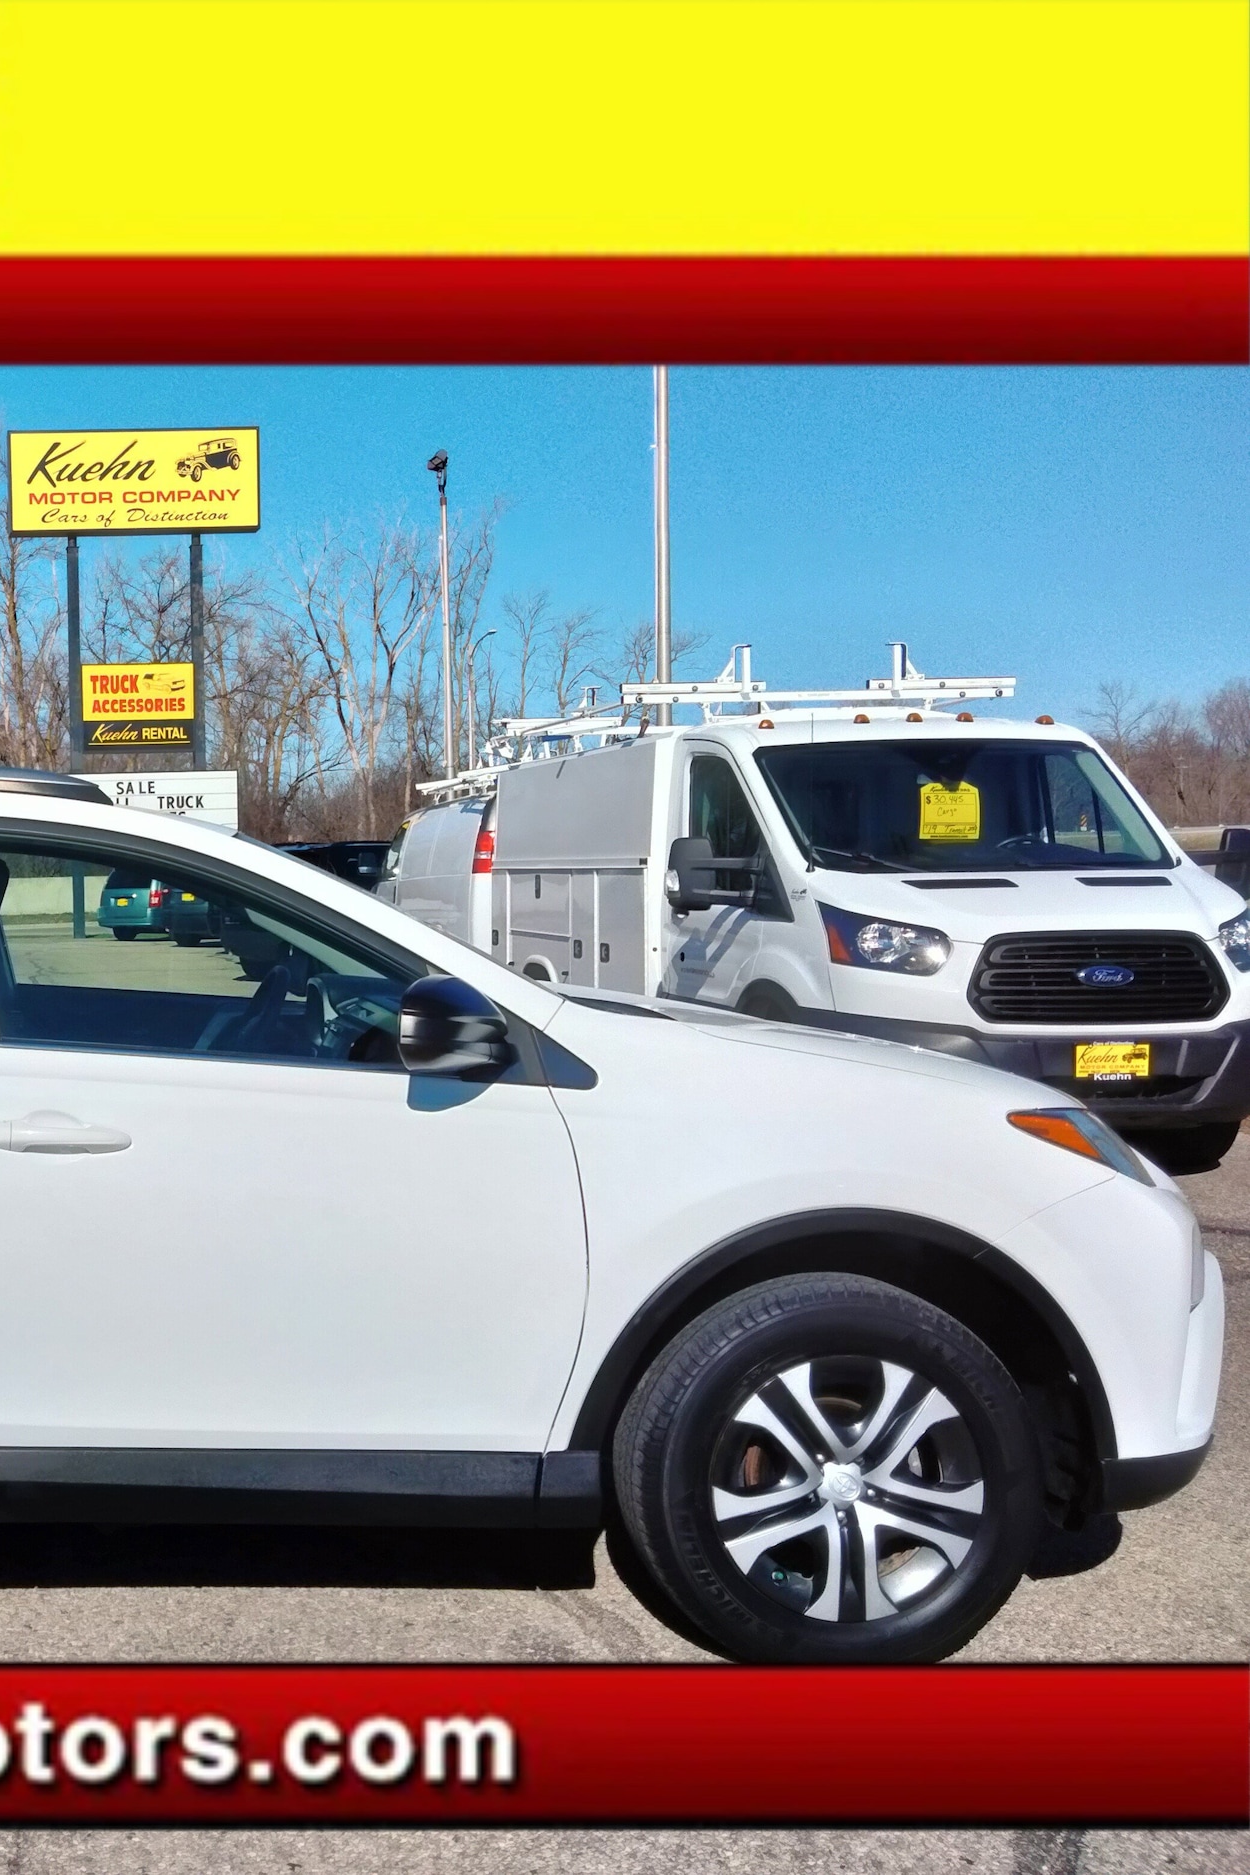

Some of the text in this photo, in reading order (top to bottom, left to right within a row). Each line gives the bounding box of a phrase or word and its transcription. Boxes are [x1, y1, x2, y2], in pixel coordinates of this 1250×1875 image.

[27, 439, 156, 488] Kuehn
[28, 488, 241, 505] MOTOR COMPANY
[41, 508, 229, 527] Cars of Distinction
[90, 674, 139, 694] TRUCK
[92, 697, 186, 713] ACCESSORIES
[91, 723, 187, 743] Kuehn RENTAL
[116, 781, 156, 795] SALE
[157, 795, 204, 809] TRUCK
[1093, 969, 1124, 982] Ford
[1078, 1046, 1119, 1065] Kuehn
[1094, 1073, 1131, 1081] Kuehn
